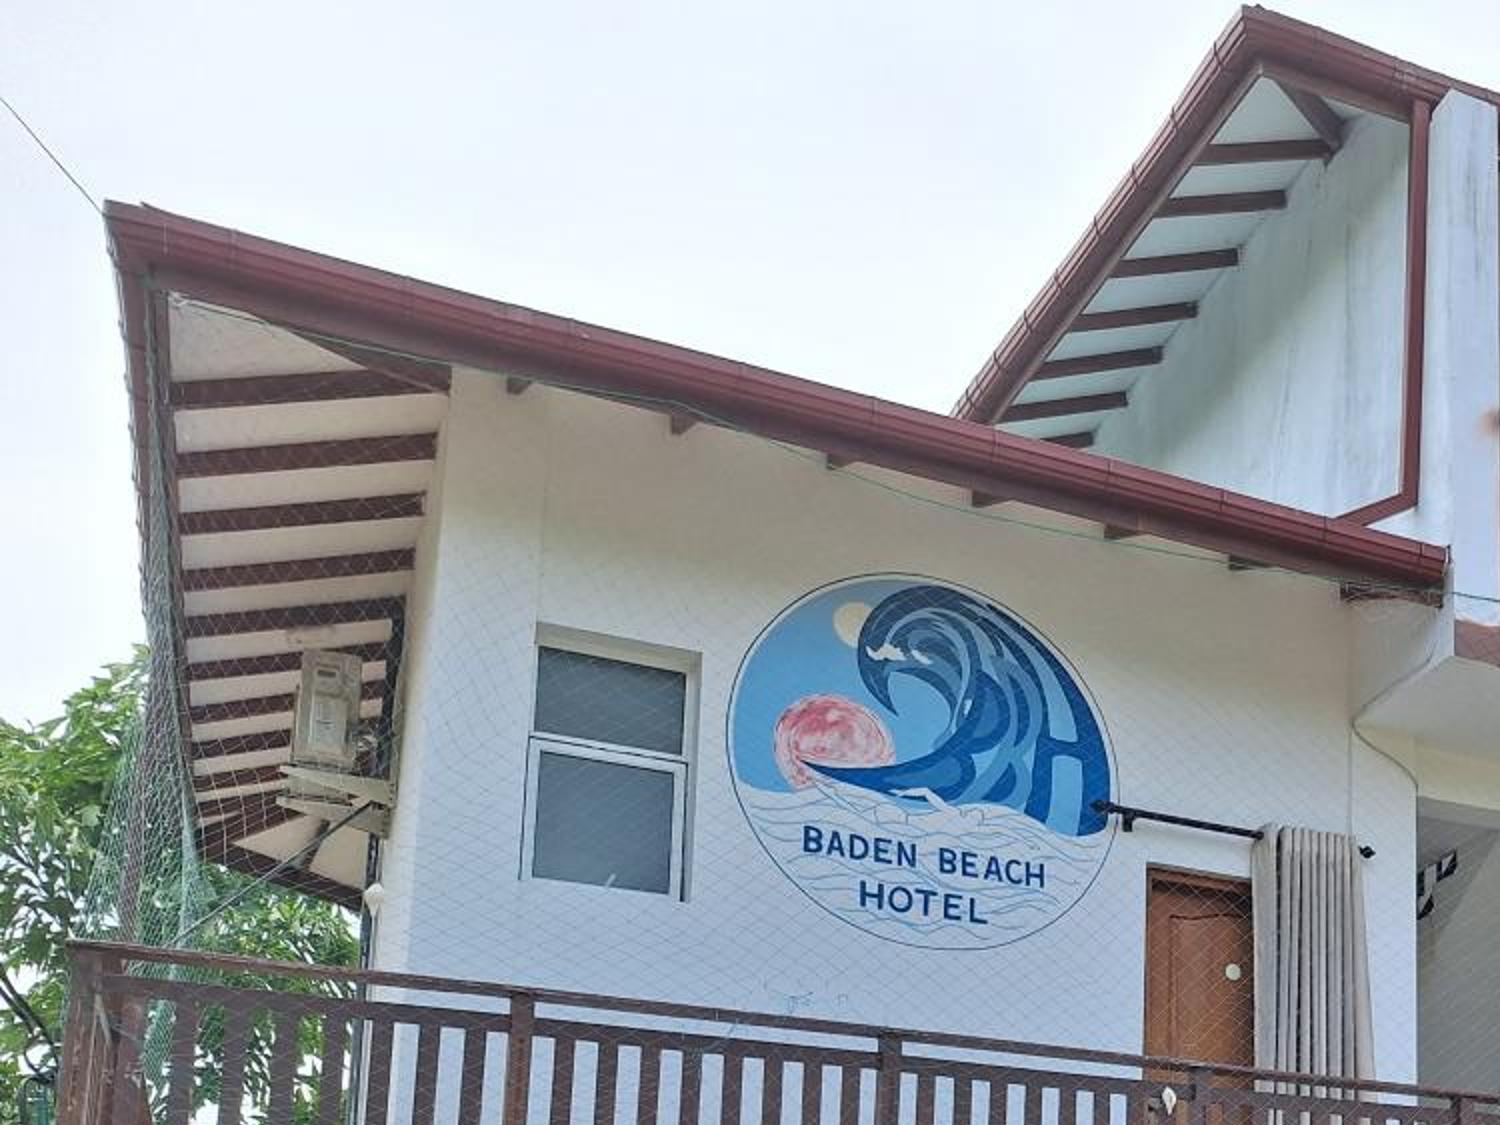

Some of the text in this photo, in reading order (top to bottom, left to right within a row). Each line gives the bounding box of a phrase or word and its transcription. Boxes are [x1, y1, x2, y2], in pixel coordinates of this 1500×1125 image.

[803, 825, 1046, 888] BADEN BEACH
[859, 880, 989, 924] HOTEL
